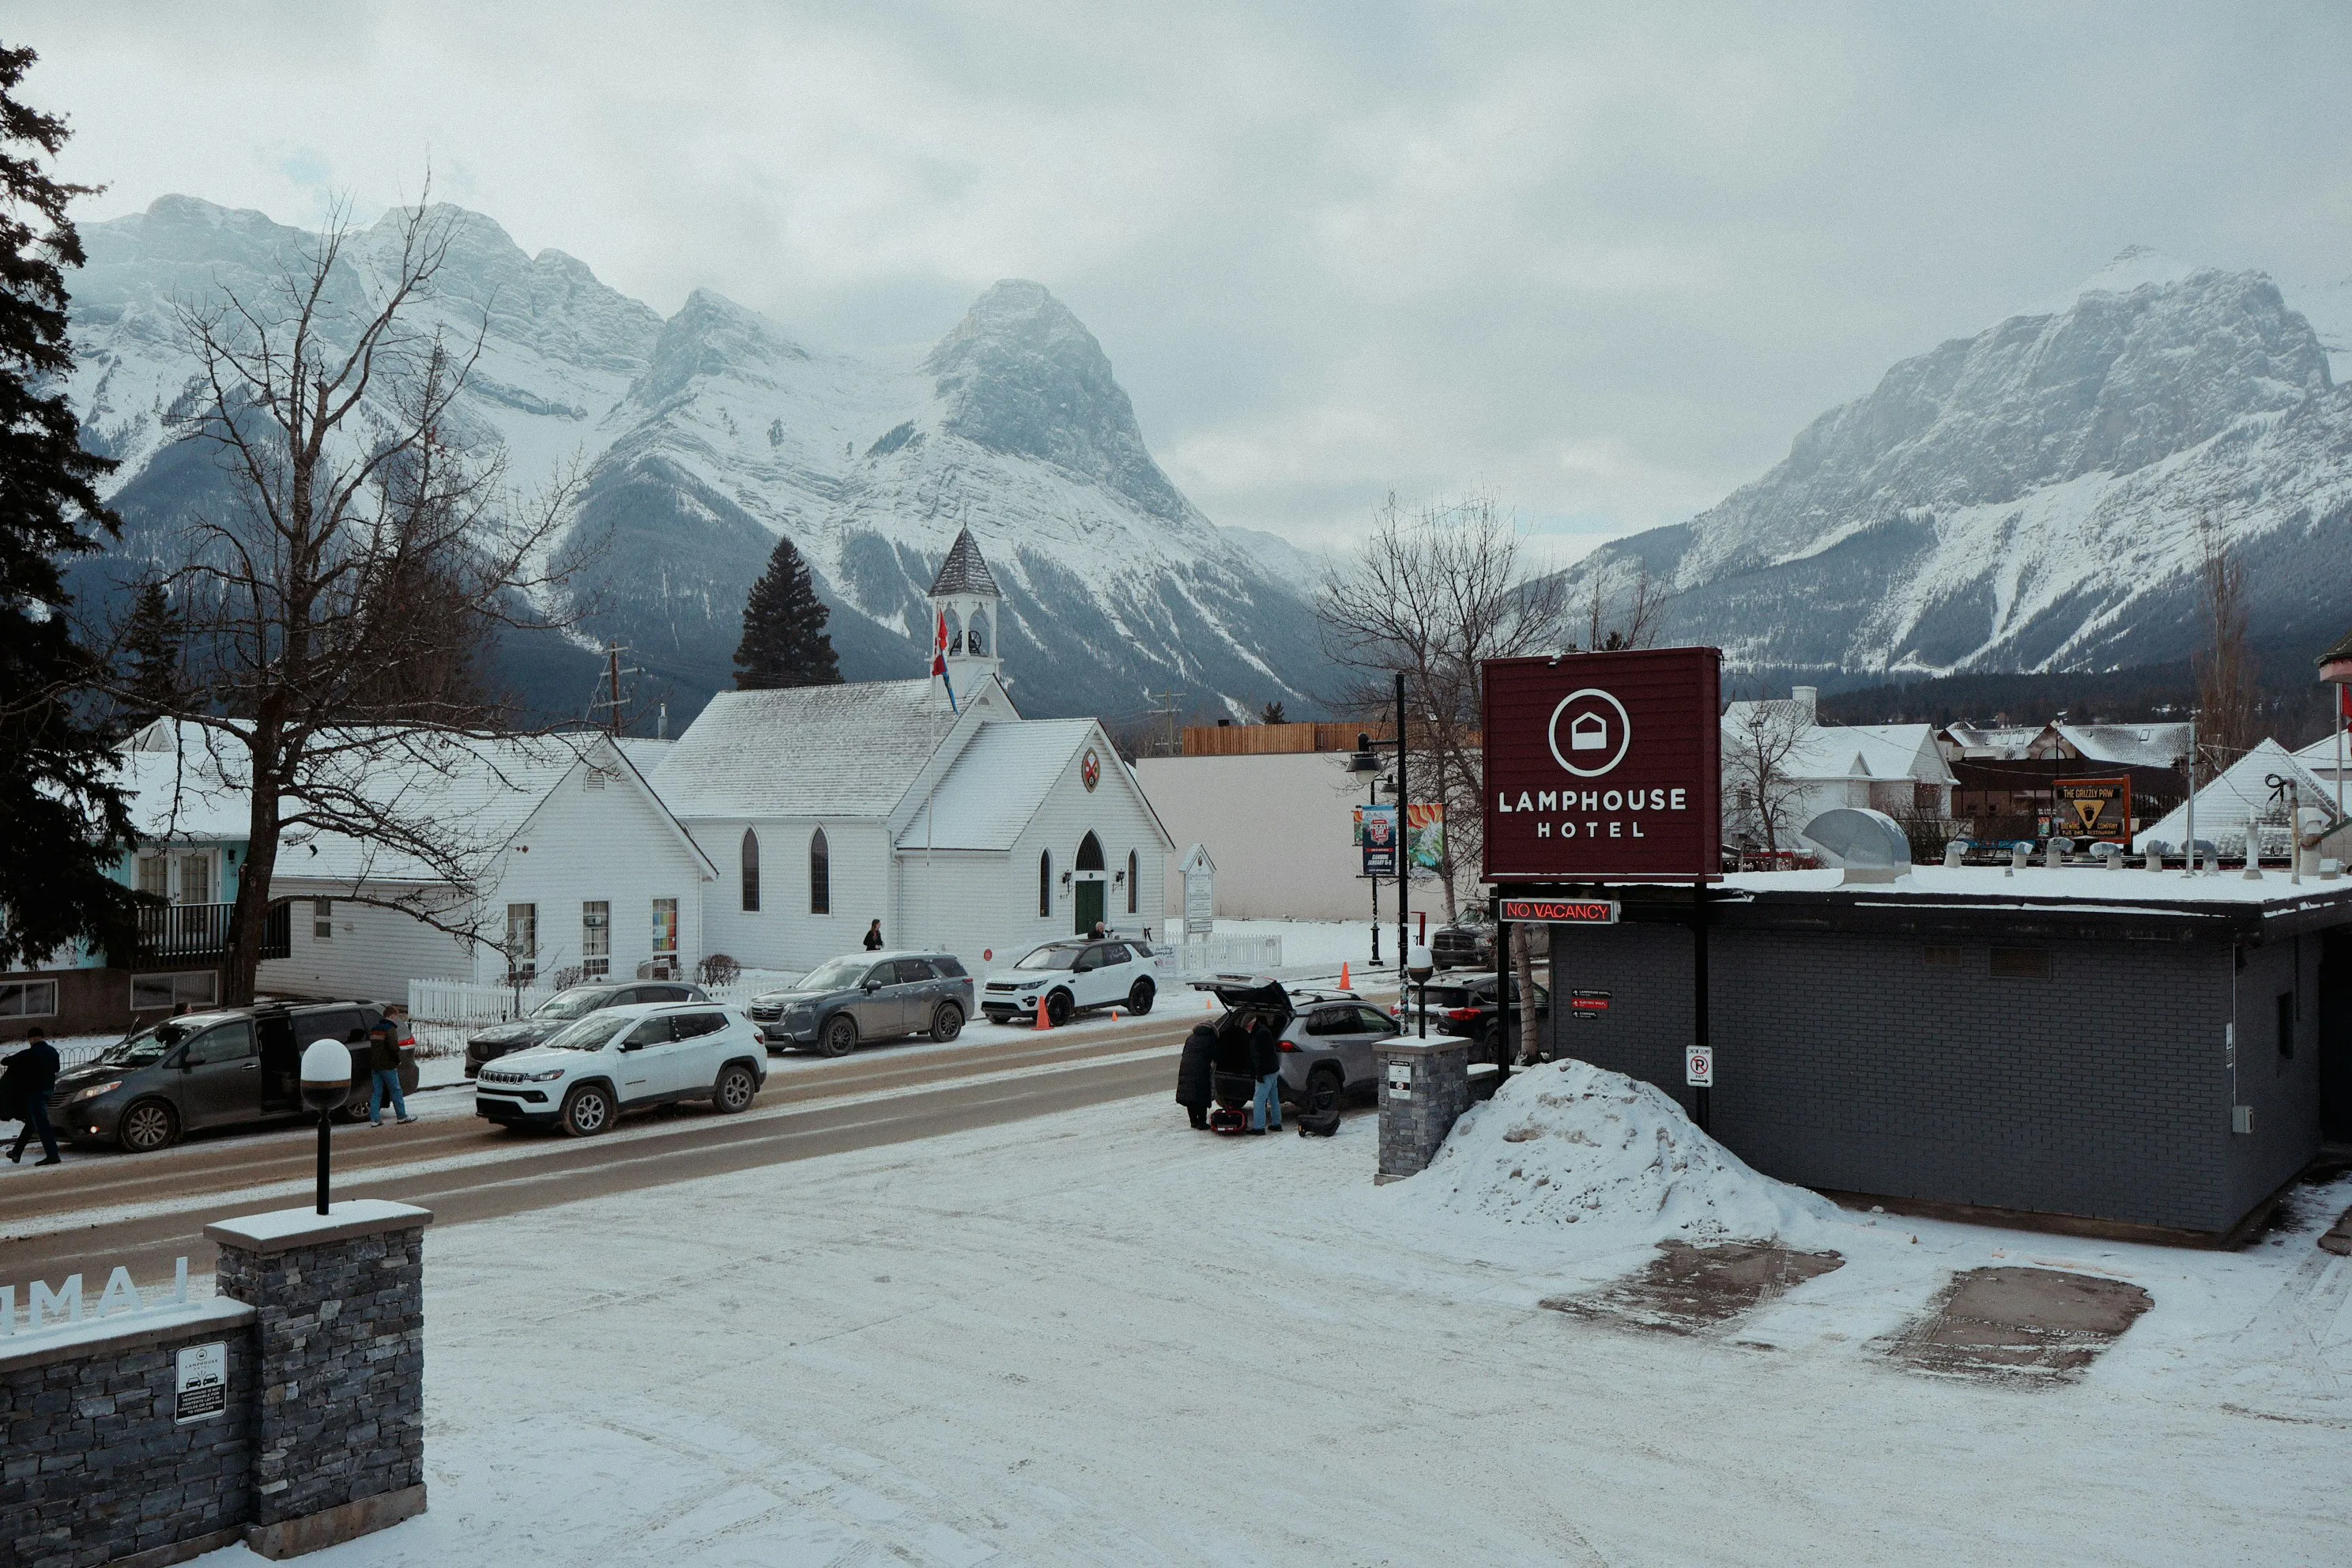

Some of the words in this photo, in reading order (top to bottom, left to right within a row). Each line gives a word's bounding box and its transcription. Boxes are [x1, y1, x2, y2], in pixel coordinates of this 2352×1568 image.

[2064, 789, 2075, 798] THE
[2075, 789, 2098, 798] GRIZZLY
[2098, 789, 2113, 798] PAW
[1498, 788, 1687, 812] LAMPHOUSE
[1537, 821, 1645, 838] HOTEL
[1507, 903, 1530, 917] NO
[1533, 903, 1608, 919] VACANCY
[185, 1359, 218, 1369] LAMPHOUSE
[181, 1389, 207, 1398] LAMPHOUSE
[183, 1393, 210, 1402] RESPONSIBLE
[178, 1404, 198, 1412] VEHICLES
[194, 1405, 214, 1414] VEHICLES
